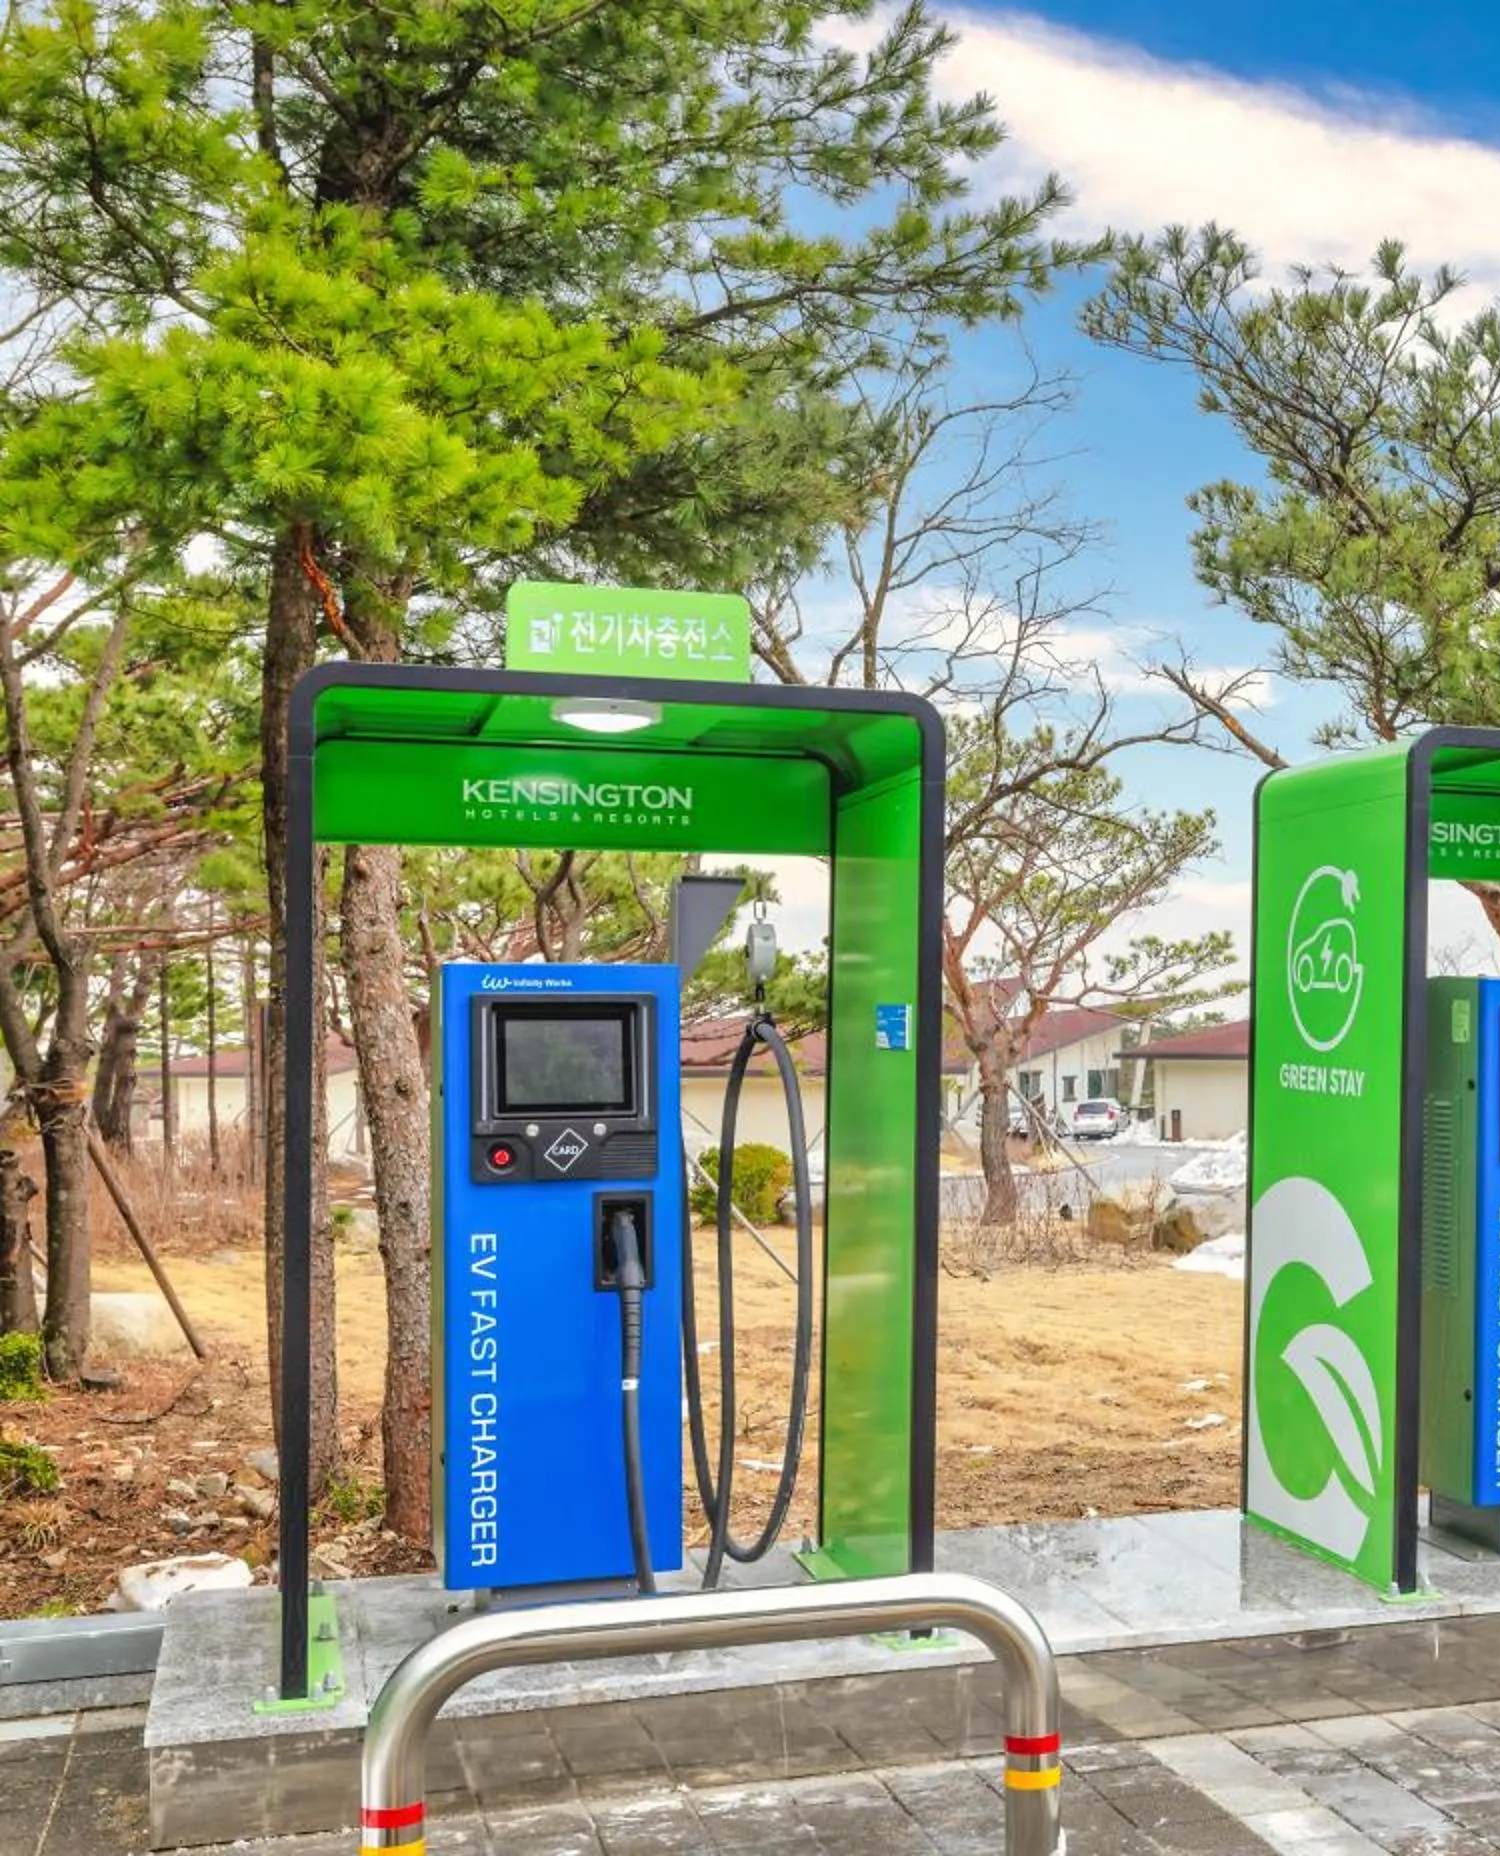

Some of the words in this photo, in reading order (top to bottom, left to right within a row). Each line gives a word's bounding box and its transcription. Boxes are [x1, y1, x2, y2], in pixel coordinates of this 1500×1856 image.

[570, 610, 735, 661] 전기차충전소
[462, 778, 693, 811] KENSINGTON
[465, 808, 558, 822] HOTELS
[593, 812, 690, 826] RESORTS
[1279, 1062, 1327, 1095] GREEN
[1329, 1067, 1365, 1097] STAY
[551, 1145, 579, 1157] CARD
[470, 1232, 497, 1279] EV
[470, 1290, 497, 1383] FAST
[470, 1392, 498, 1567] CHARGER
